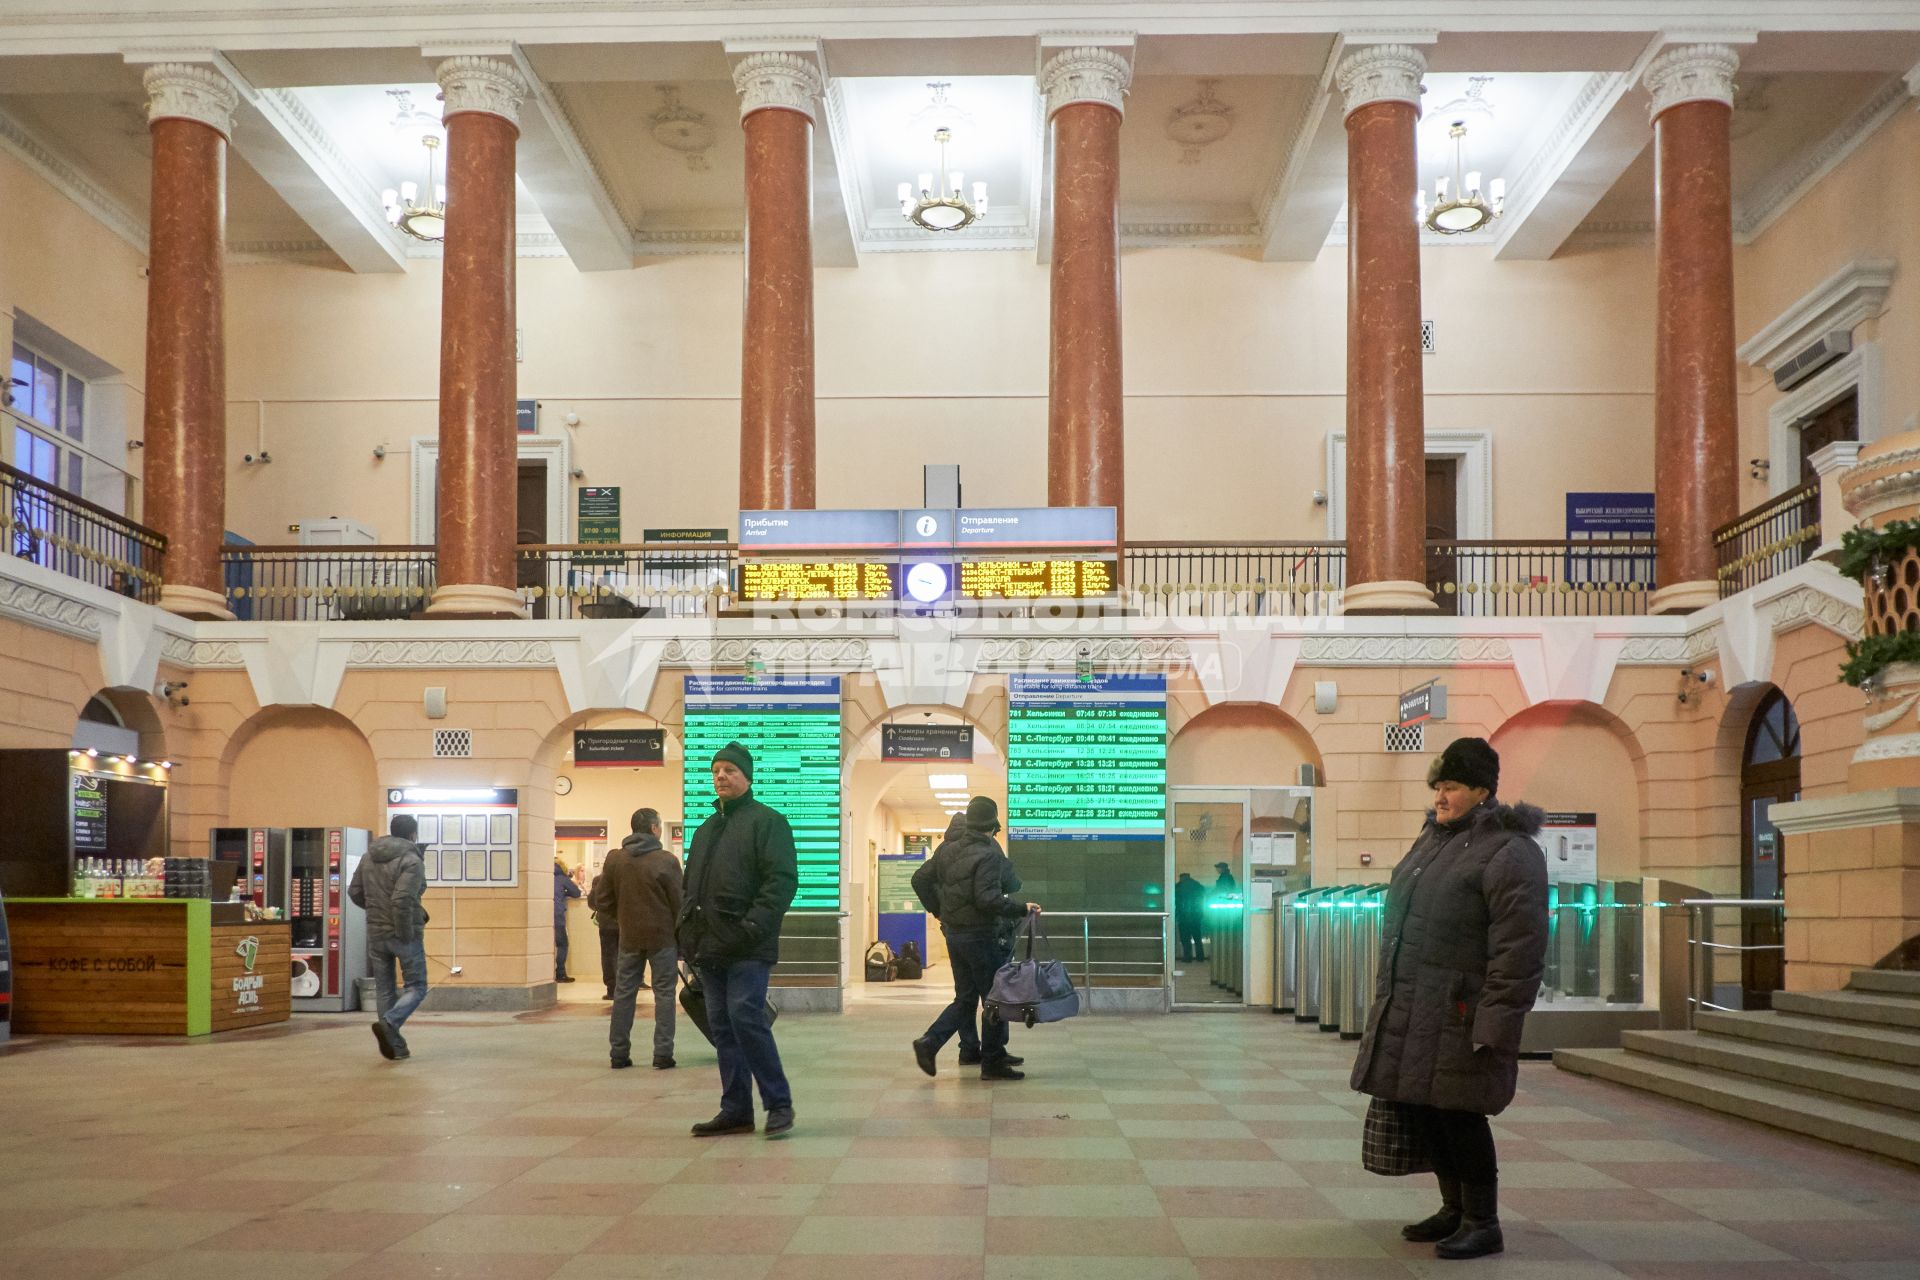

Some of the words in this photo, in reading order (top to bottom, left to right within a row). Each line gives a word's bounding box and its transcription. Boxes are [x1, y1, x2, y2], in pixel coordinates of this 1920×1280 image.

[745, 518, 789, 528] Прибытие
[961, 516, 1019, 526] Отправление
[961, 527, 994, 535] Departure
[761, 563, 802, 571] ХЕЛЬСИНКИ
[814, 563, 830, 571] СПБ
[978, 561, 1020, 569] ХЕЛЬСИНКИ
[1031, 561, 1046, 569] СПБ
[978, 568, 1044, 576] САНКТ-ПЕТЕРБУРГ
[761, 577, 810, 585] ЗЕЛЕНОГОРСК
[978, 582, 1044, 590] САНКТ-ПЕТЕРБУРГ
[761, 591, 776, 599] СПБ
[788, 591, 830, 599] ХЕЛЬСИНКИ
[978, 589, 993, 597] СПБ
[1004, 589, 1047, 597] ХЕЛЬСИНКИ
[1026, 735, 1073, 744] С.-Петербург
[1026, 760, 1072, 768] С.-Петербург
[1026, 785, 1072, 794] С.-Петербург
[1025, 810, 1072, 818] С.-Петербург
[600, 828, 606, 837] 2
[50, 958, 87, 972] КОФЕ
[93, 958, 101, 972] С
[108, 956, 156, 972] СОБОЙ
